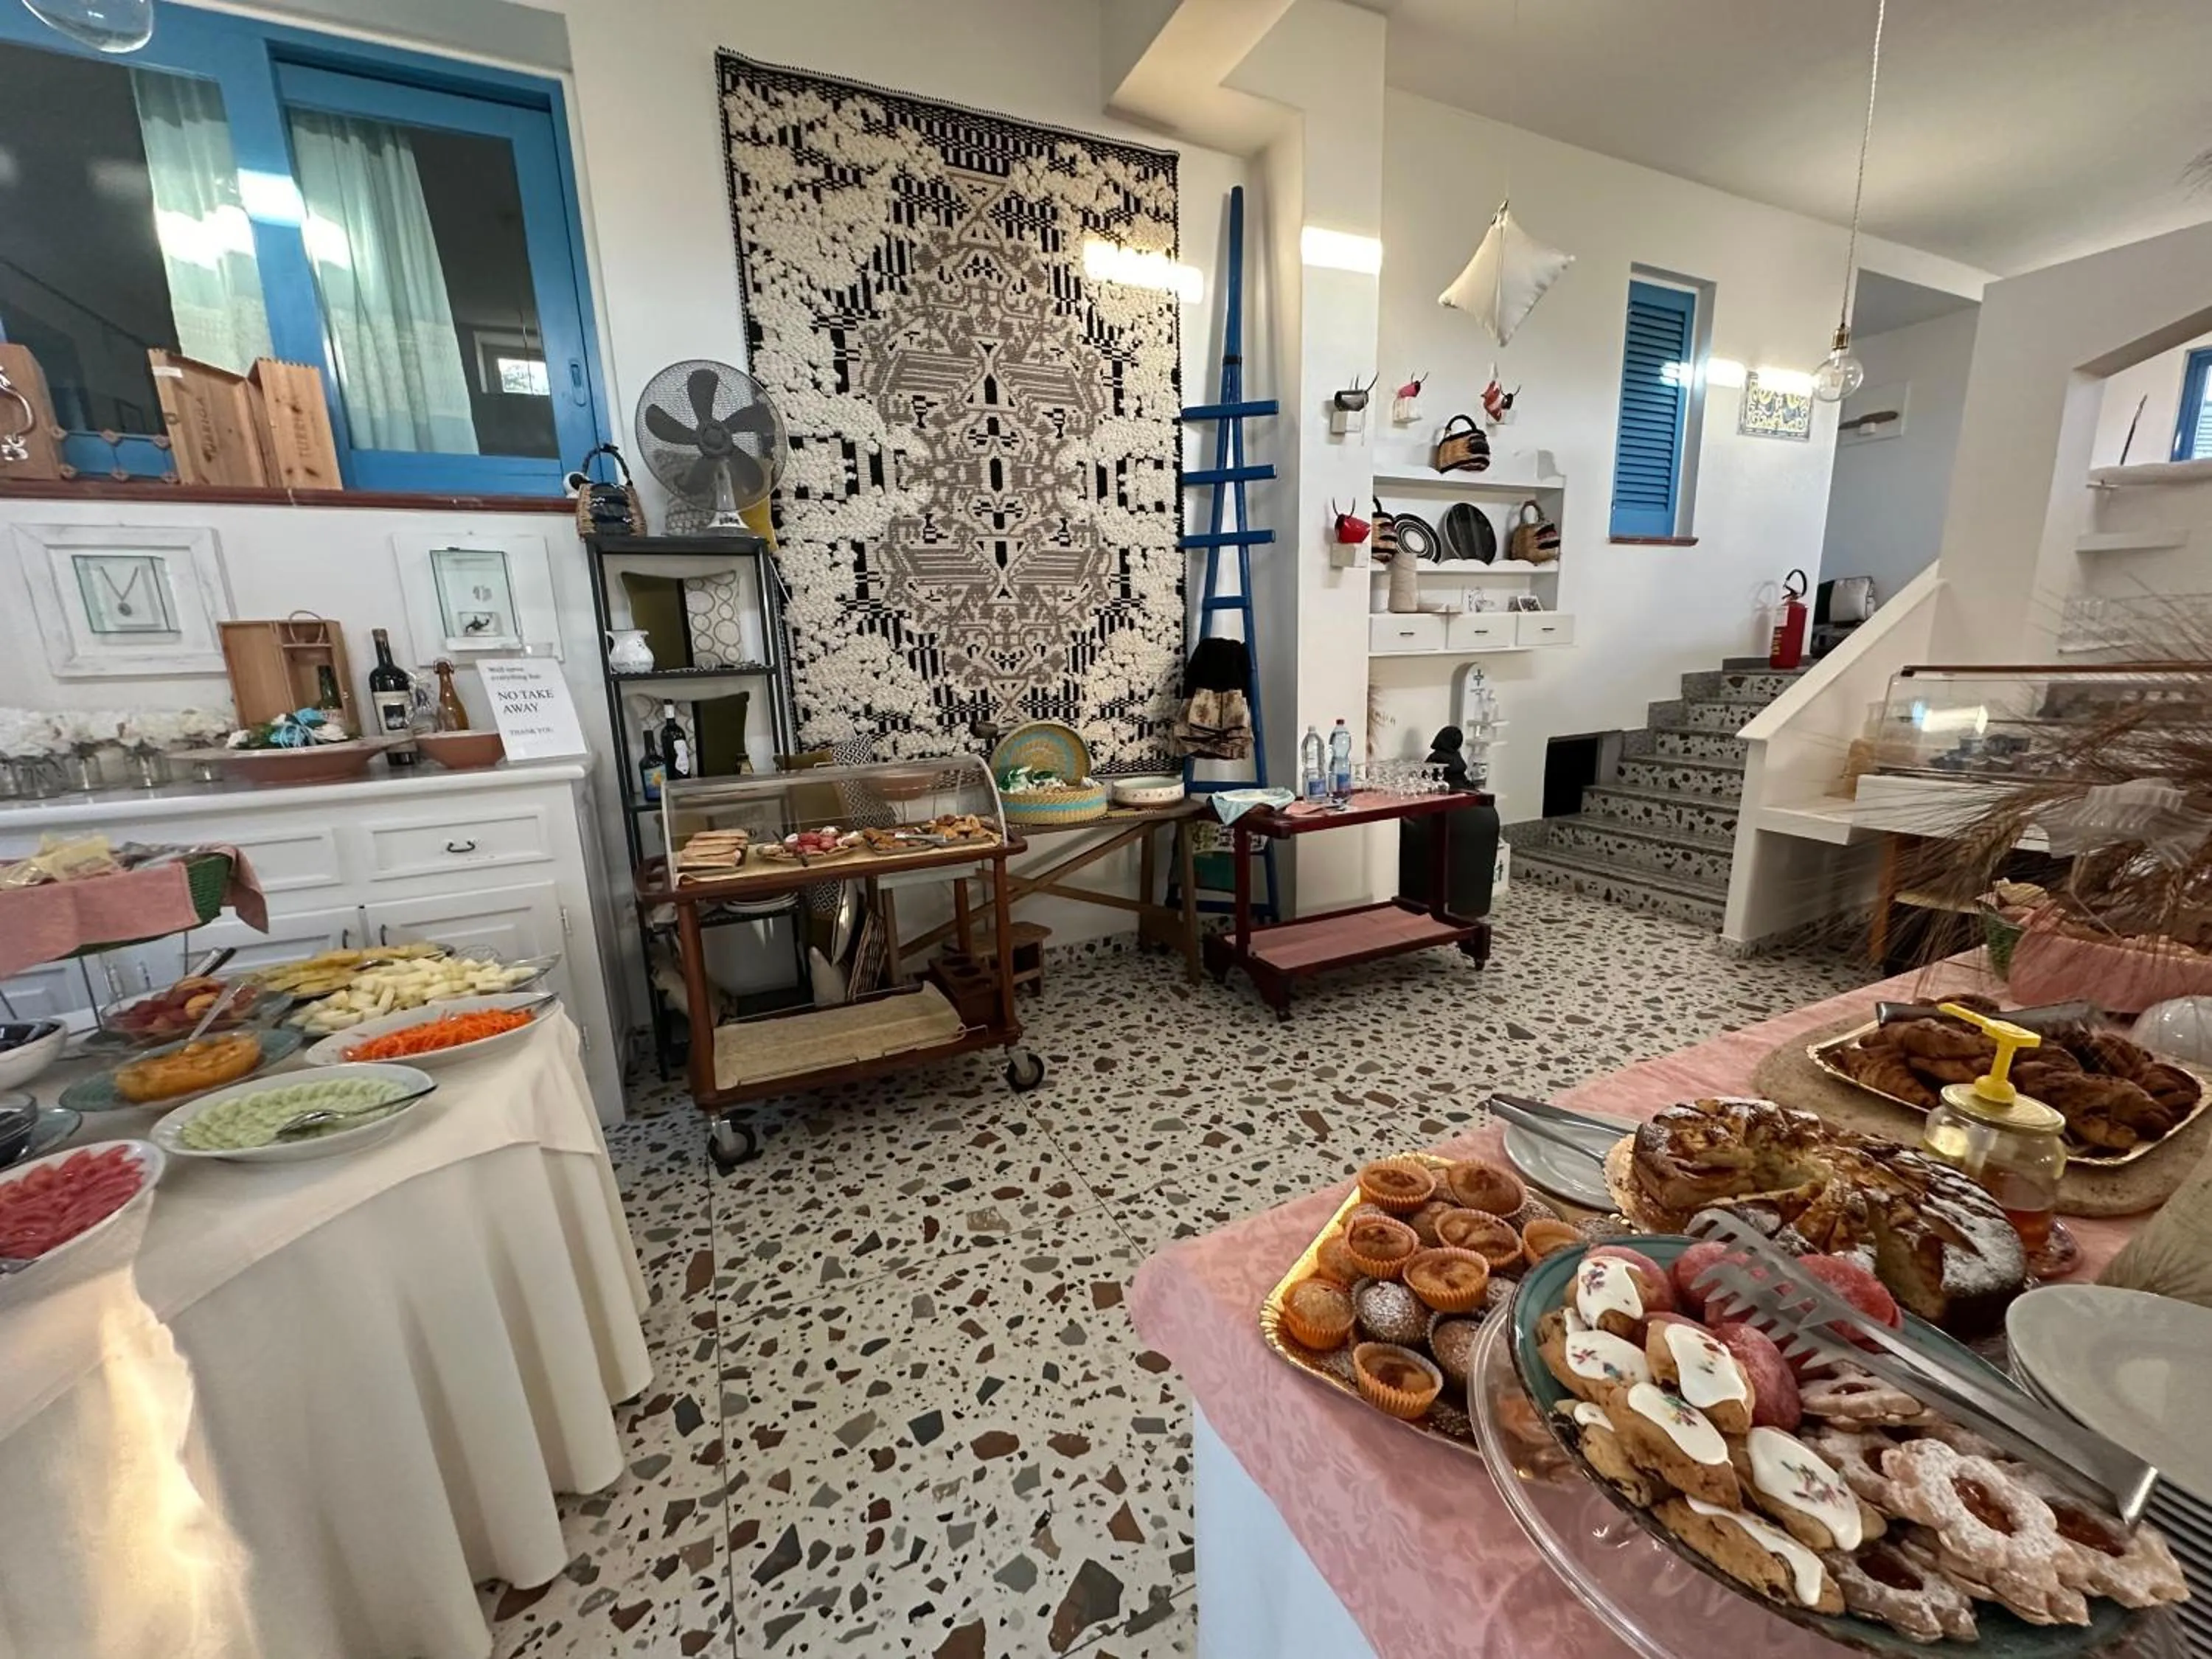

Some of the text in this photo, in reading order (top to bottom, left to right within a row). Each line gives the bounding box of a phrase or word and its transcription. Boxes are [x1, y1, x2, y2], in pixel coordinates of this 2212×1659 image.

[498, 689, 554, 701] NO TAKE
[503, 703, 539, 714] AWAY
